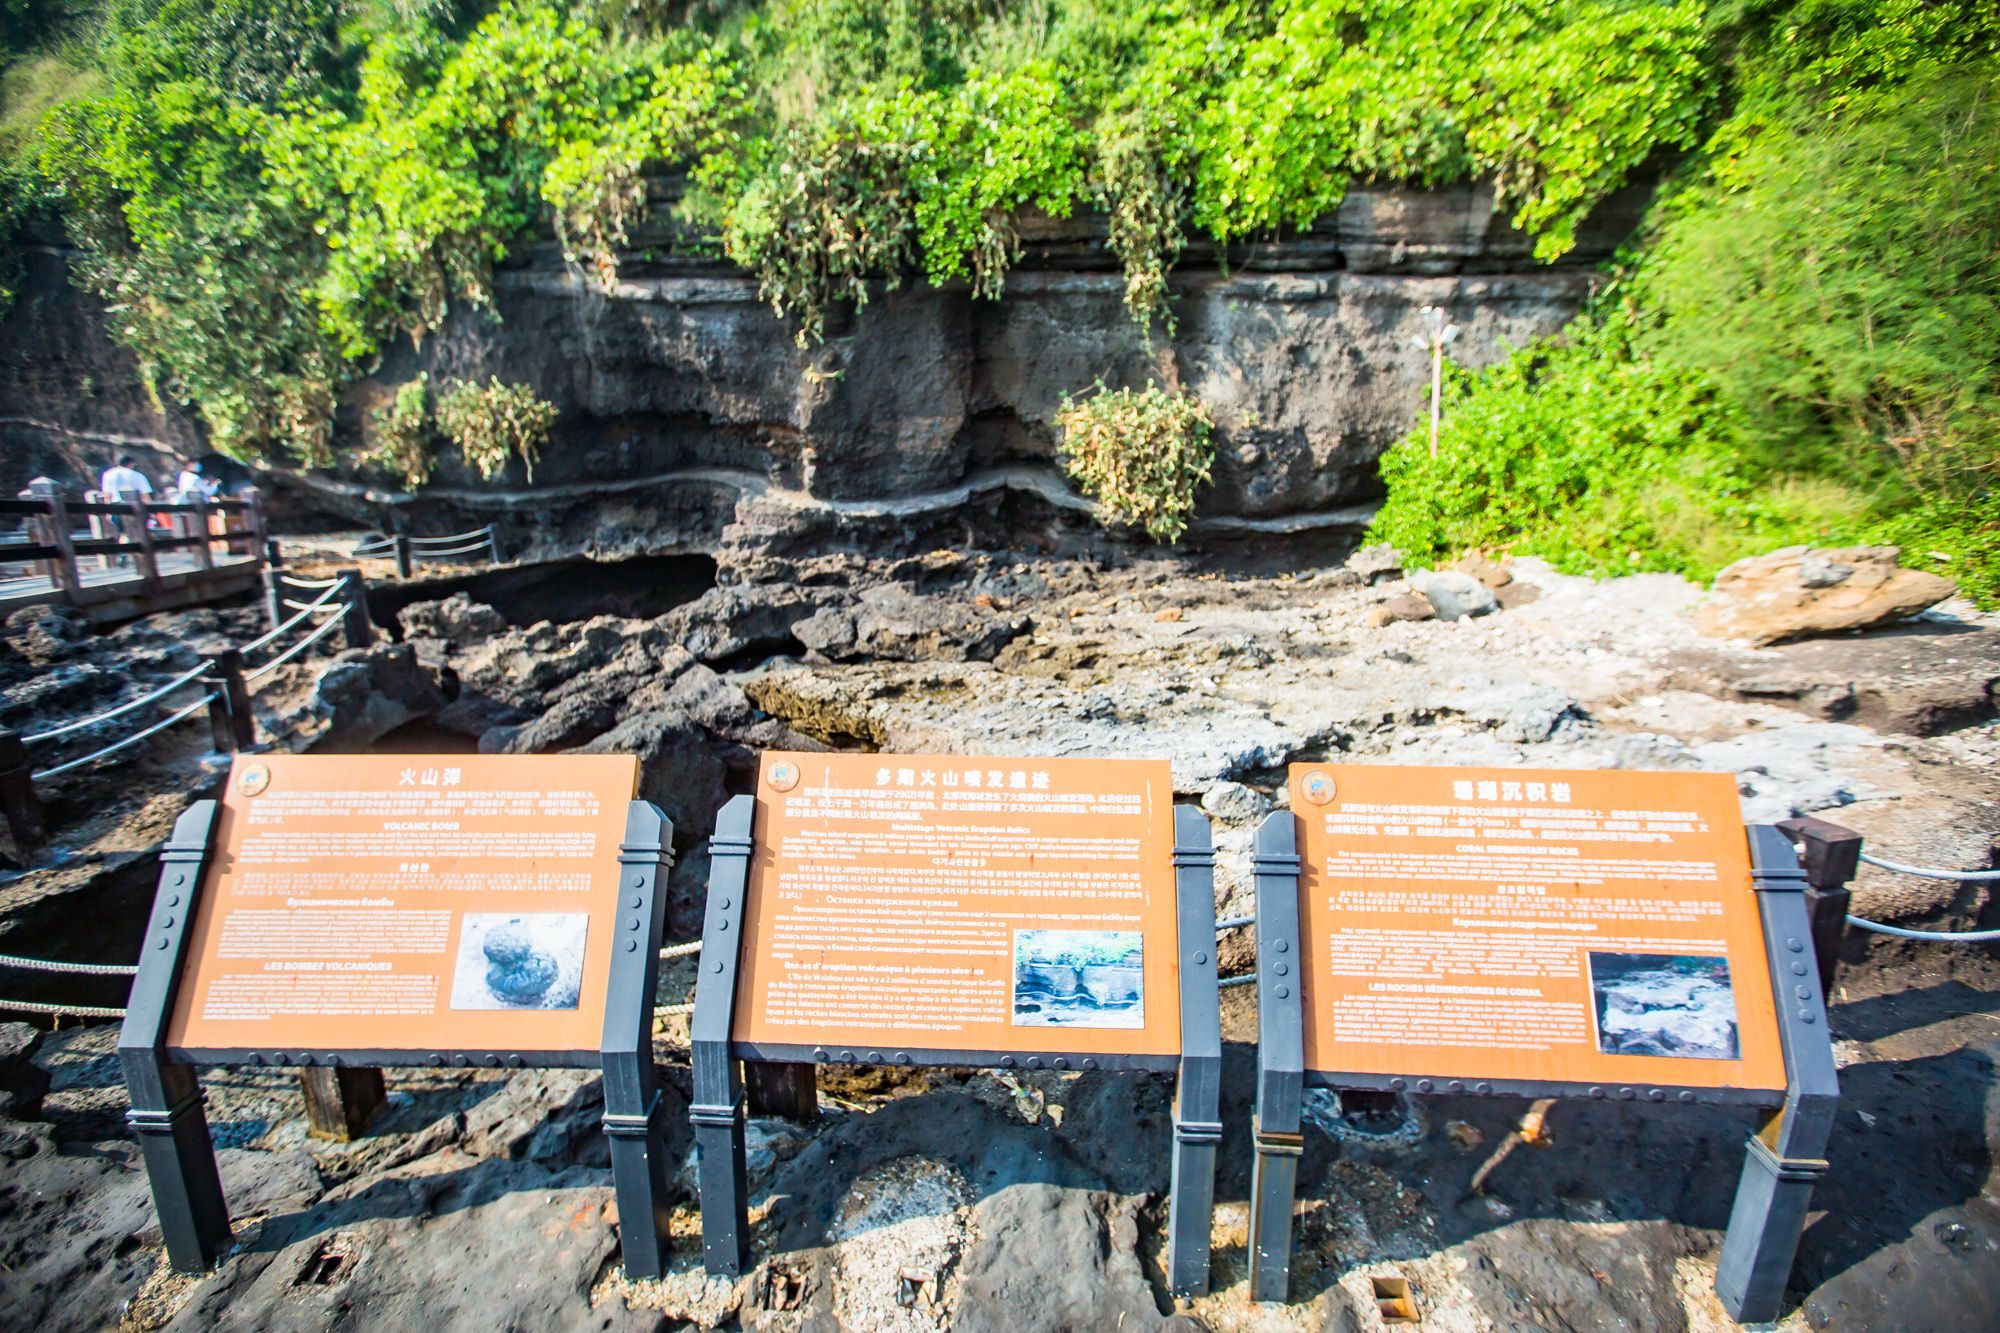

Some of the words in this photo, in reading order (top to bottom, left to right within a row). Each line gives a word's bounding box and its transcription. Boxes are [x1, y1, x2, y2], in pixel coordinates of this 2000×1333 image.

[398, 768, 462, 786] 火山弹
[384, 822, 429, 830] VOLCANIC
[431, 822, 460, 830] BOMB
[892, 824, 934, 832] Multistage
